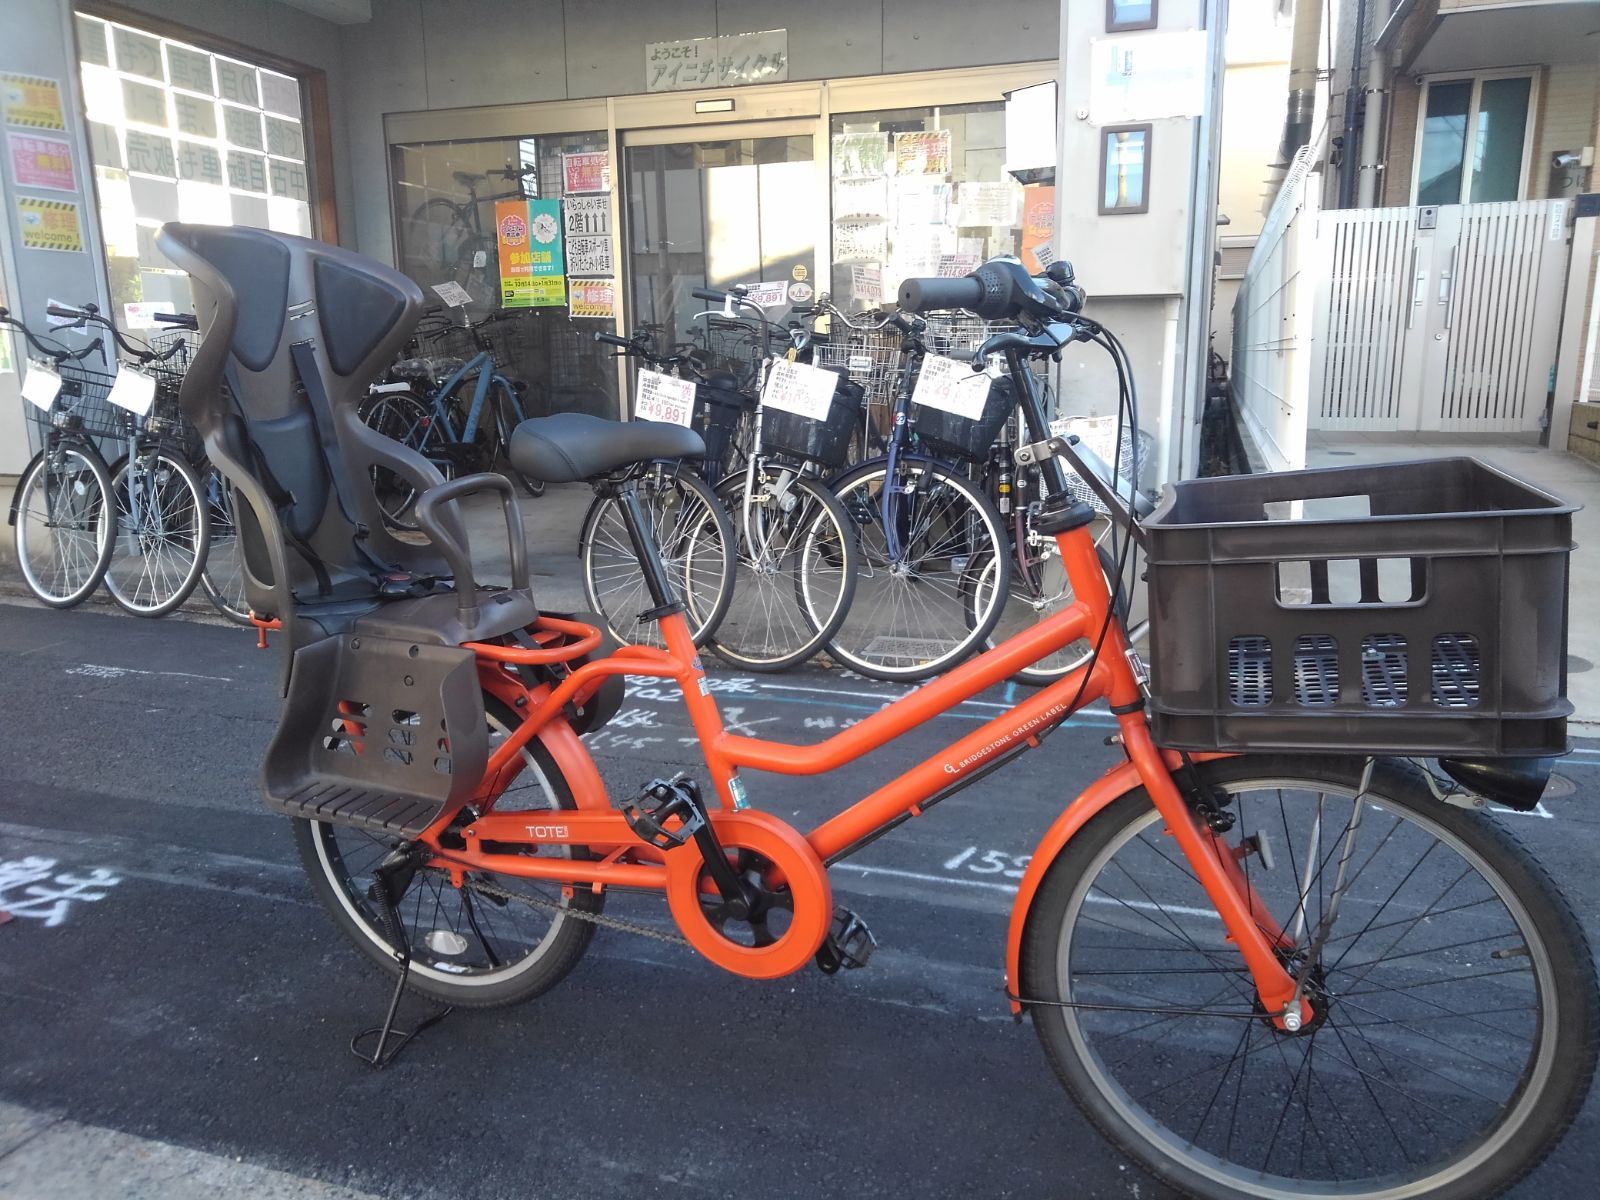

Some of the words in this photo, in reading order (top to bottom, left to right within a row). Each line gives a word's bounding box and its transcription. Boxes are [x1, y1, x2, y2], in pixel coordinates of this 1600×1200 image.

[566, 199, 607, 210] いらっしゃいませ
[569, 212, 583, 232] 2階
[648, 402, 687, 425] ¥9,891
[959, 734, 1012, 768] BRIDGESTONE
[1012, 718, 1041, 737] GREEN
[1040, 703, 1068, 721] LABEL
[525, 825, 565, 838] TOTE
